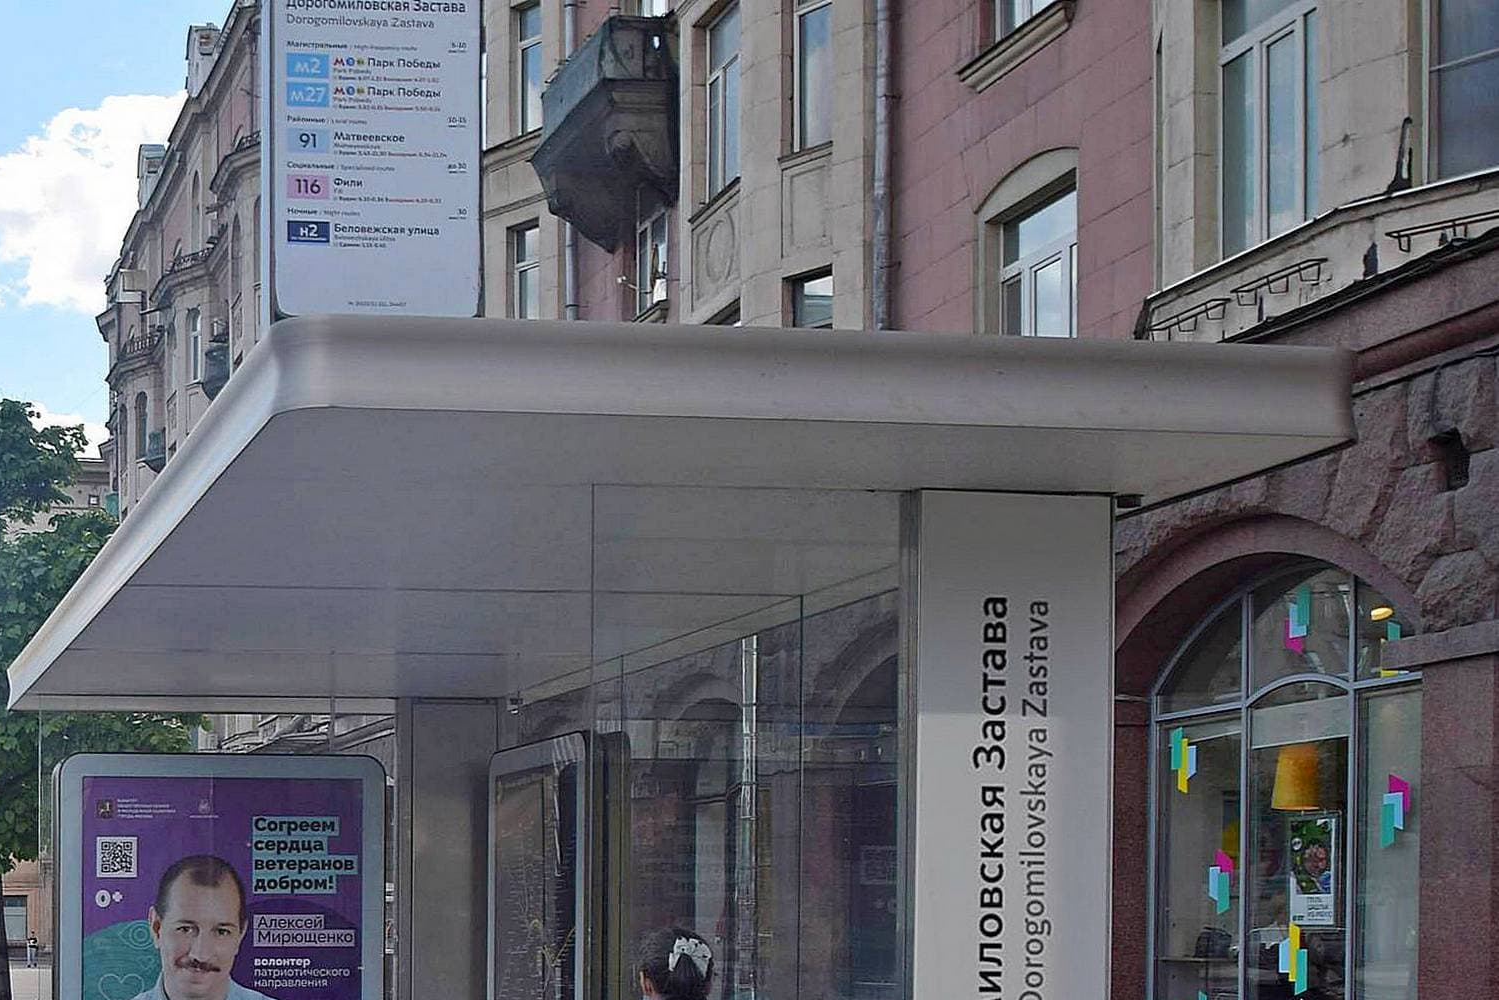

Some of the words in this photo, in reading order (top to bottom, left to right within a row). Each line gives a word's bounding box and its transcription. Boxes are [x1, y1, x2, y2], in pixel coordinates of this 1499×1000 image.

[413, 0, 466, 13] Застава
[286, 13, 389, 29] Dorogomilovskaya
[391, 17, 435, 29] Zastava
[367, 57, 395, 69] Парк
[397, 58, 441, 69] Победы
[367, 86, 395, 97] Парк
[397, 87, 441, 98] Победы
[299, 132, 317, 149] 91
[334, 131, 405, 142] Матвеевское
[295, 178, 321, 194] 116
[334, 177, 363, 187] Фили
[334, 223, 405, 234] Беловежская
[407, 227, 440, 236] улица
[1021, 600, 1048, 717] Zastava
[973, 596, 1008, 770] Застава
[254, 817, 335, 836] Согреем
[254, 839, 324, 854] сердца
[254, 857, 355, 874] ветеранов
[254, 876, 334, 894] добром!
[257, 915, 324, 929] Алексей
[257, 930, 353, 947] Мирющенко
[254, 957, 311, 969] волонтер
[254, 968, 351, 980] патриотического
[254, 978, 328, 989] направления
